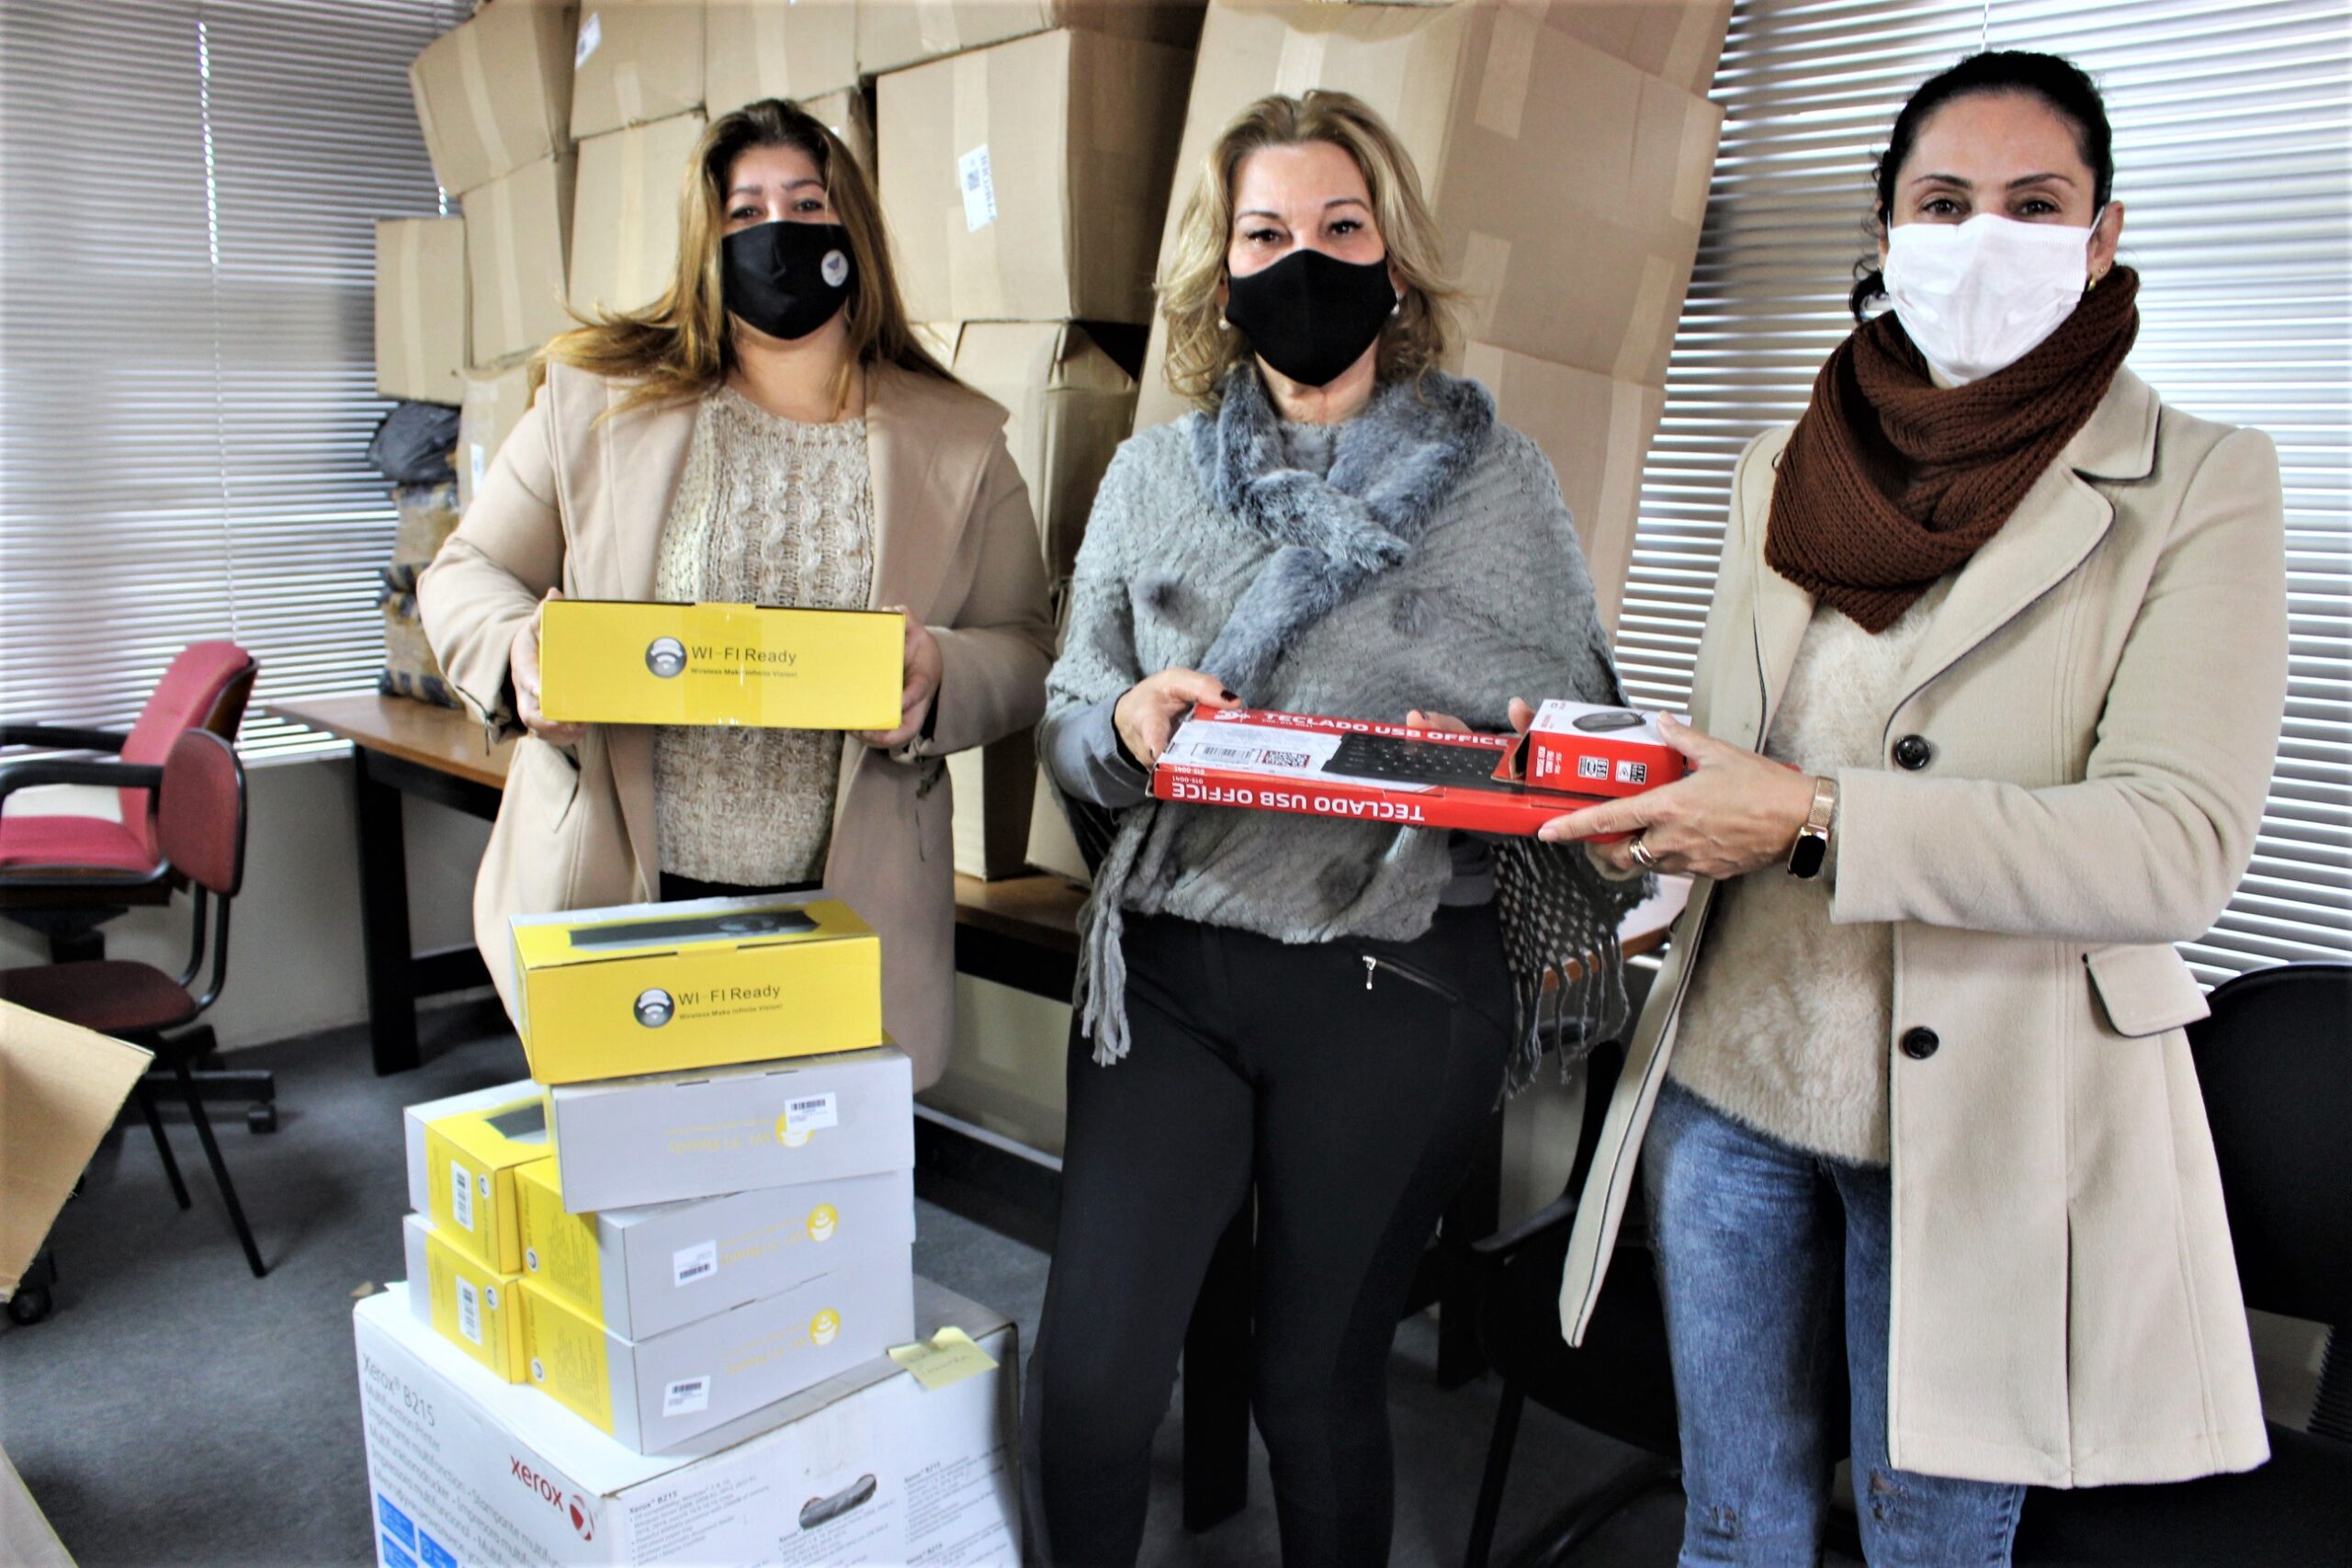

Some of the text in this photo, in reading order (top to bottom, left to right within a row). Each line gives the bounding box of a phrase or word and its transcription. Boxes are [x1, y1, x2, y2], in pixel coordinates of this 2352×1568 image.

[745, 647, 797, 665] Ready
[1264, 713, 1369, 732] TECLADO
[1374, 727, 1422, 739] USB
[1427, 732, 1510, 748] OFFICE
[1171, 782, 1425, 821] TECLADO USB OFFICE
[730, 985, 781, 1000] Ready
[403, 1385, 435, 1427] B215
[510, 1454, 563, 1512] xerox
